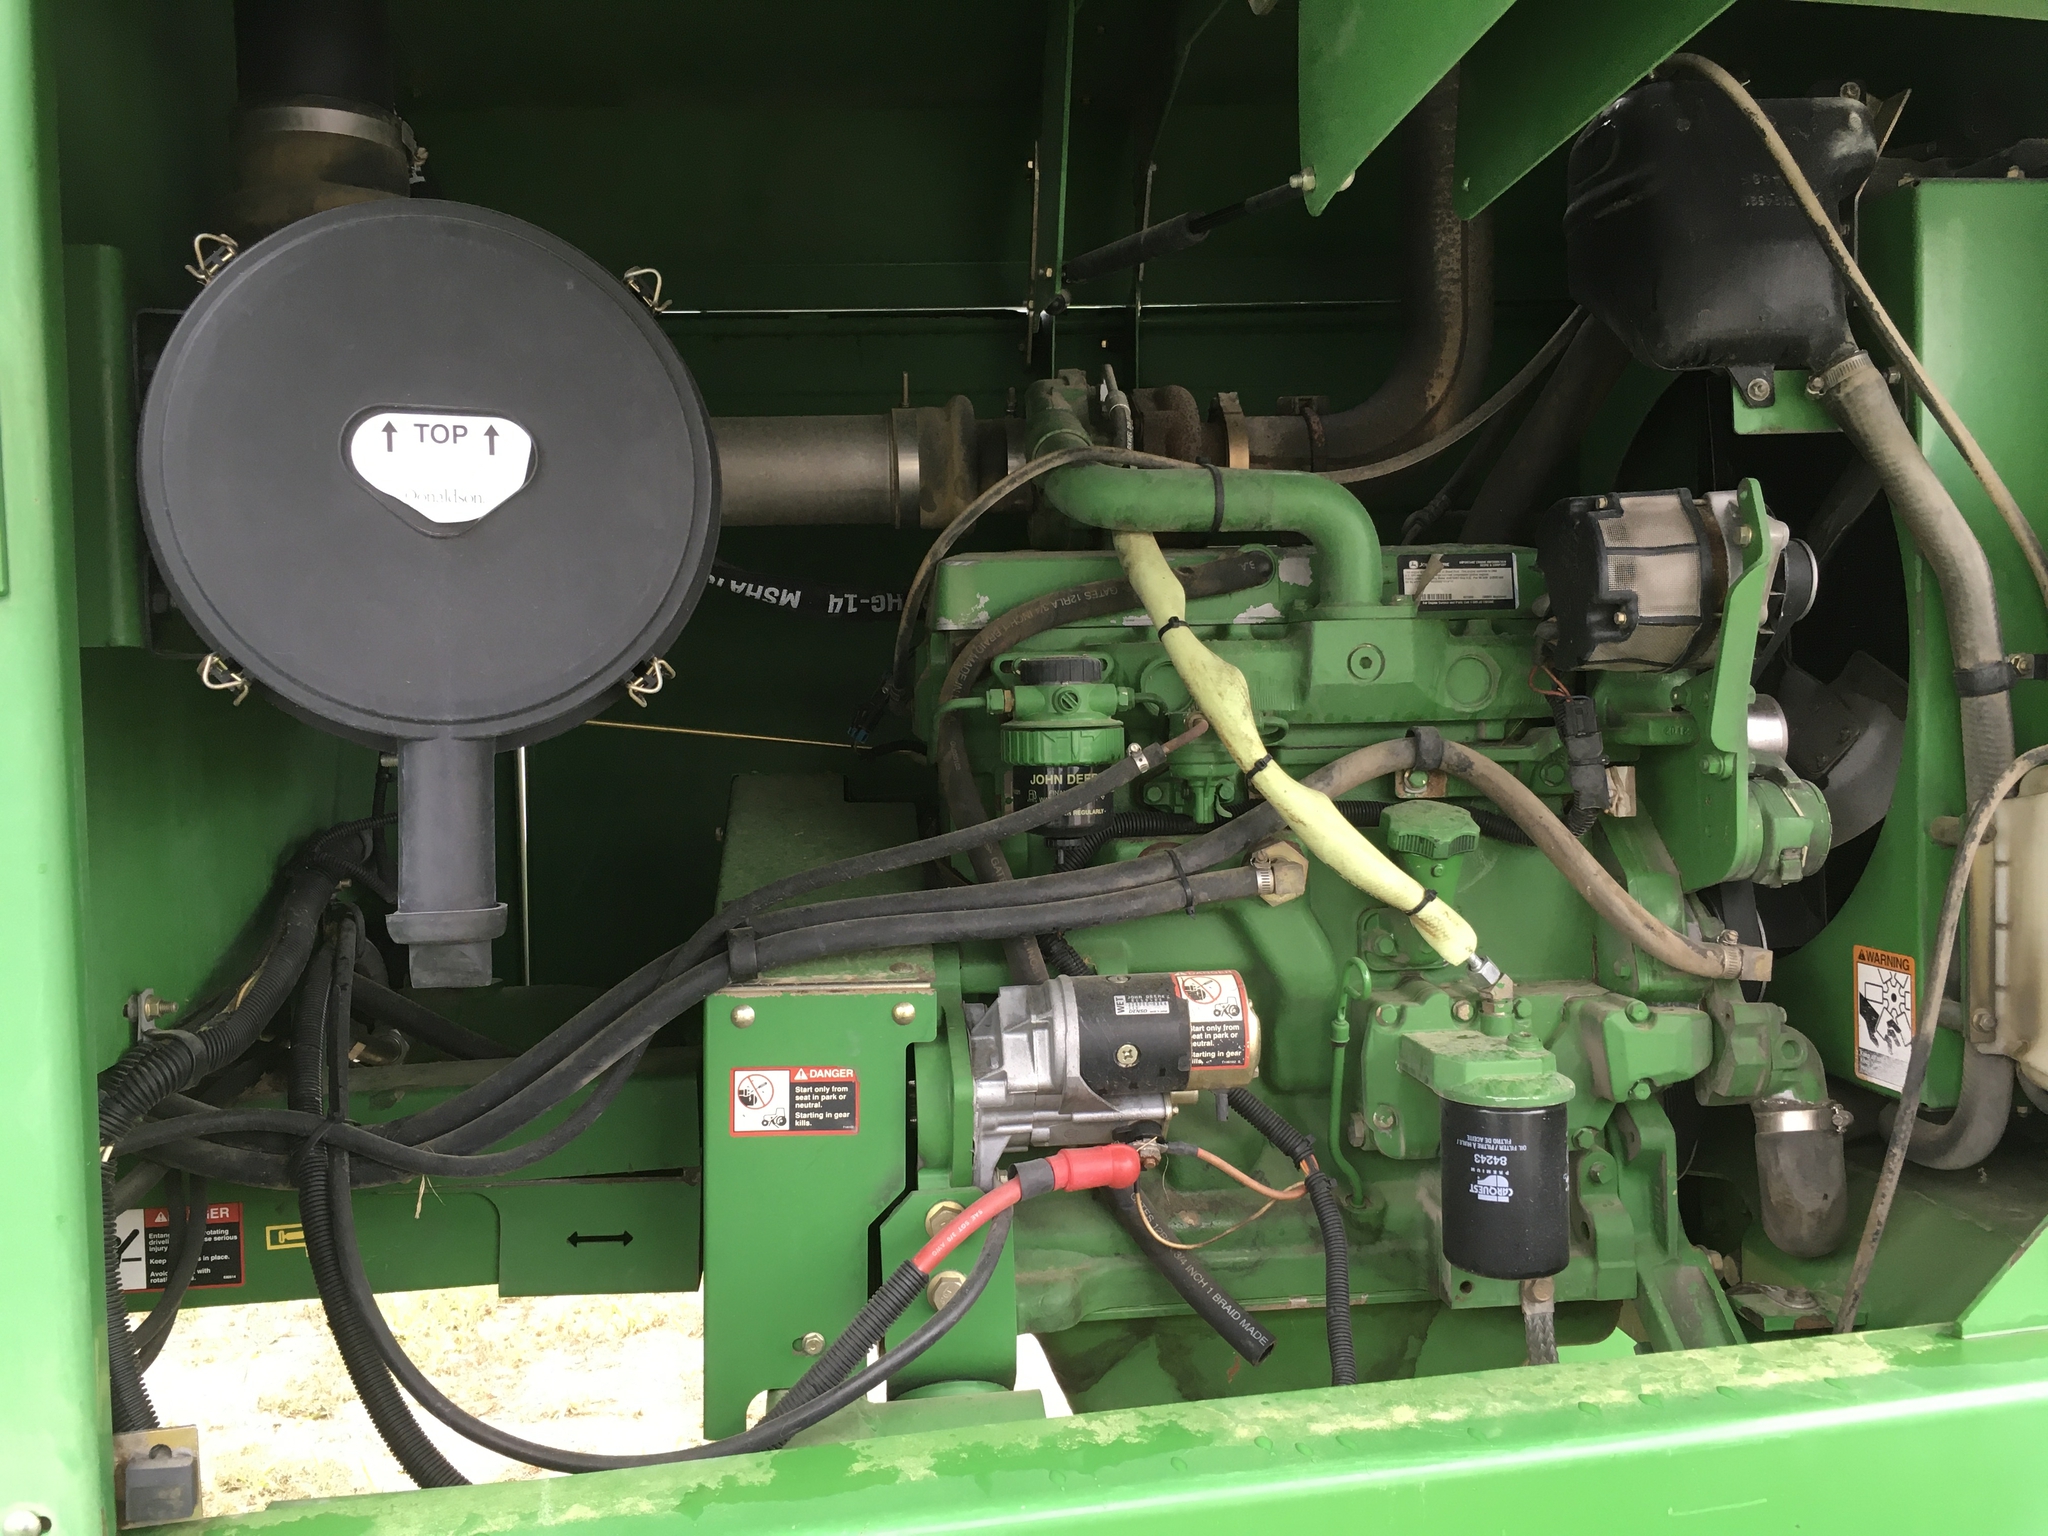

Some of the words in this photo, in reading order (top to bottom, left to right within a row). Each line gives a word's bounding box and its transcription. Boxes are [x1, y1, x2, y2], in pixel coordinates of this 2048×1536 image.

[413, 423, 468, 444] TOP
[730, 579, 802, 609] MSHA
[1084, 586, 1118, 600] GATES
[1051, 594, 1081, 609] 12RLA
[1011, 609, 1033, 627] INCH
[1030, 774, 1063, 785] JOHN
[1866, 950, 1910, 971] WARNING
[1116, 997, 1125, 1013] WET
[1206, 1024, 1221, 1032] only
[1213, 1032, 1229, 1040] park
[809, 1069, 853, 1078] DANGER
[814, 1086, 830, 1094] only
[821, 1094, 837, 1102] park
[795, 1112, 823, 1120] Starting
[1474, 1153, 1507, 1166] 84243
[1470, 1167, 1509, 1175] PREMIUM
[1469, 1184, 1513, 1197] CARQUEST
[971, 1209, 983, 1221] SAE
[210, 1254, 230, 1262] place.
[1173, 1251, 1187, 1266] 3/4
[1185, 1264, 1208, 1289] INCH
[1212, 1293, 1241, 1321] BRAID
[1239, 1318, 1269, 1346] MADE
